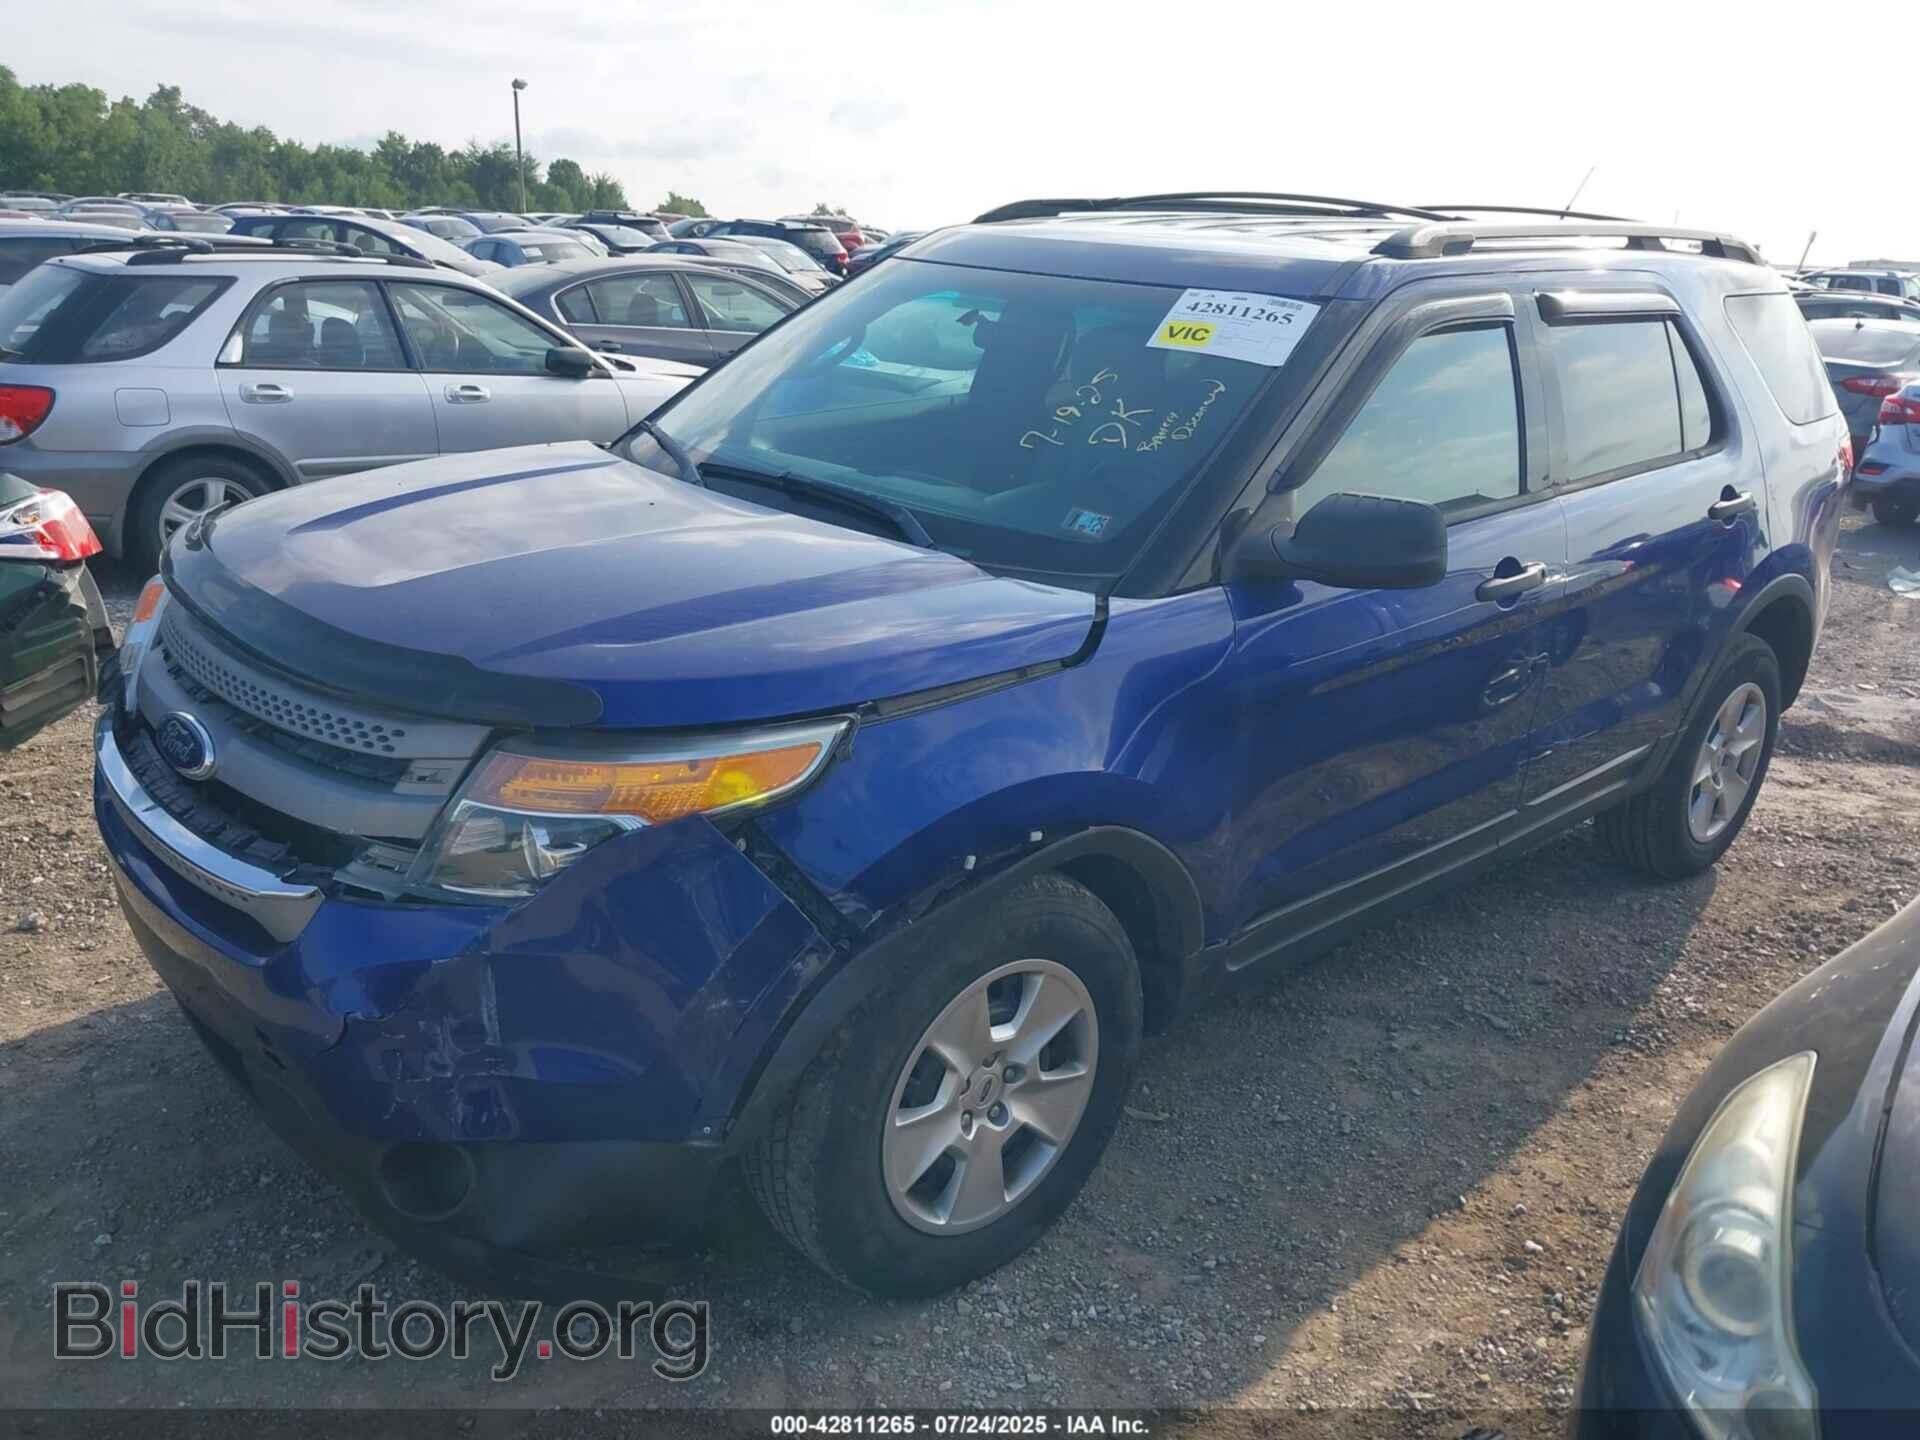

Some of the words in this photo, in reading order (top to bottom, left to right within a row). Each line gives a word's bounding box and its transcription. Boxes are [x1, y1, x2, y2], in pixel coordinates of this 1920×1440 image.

[1186, 302, 1295, 325] 42811265
[1168, 325, 1210, 341] VIC
[1088, 399, 1153, 448] DK
